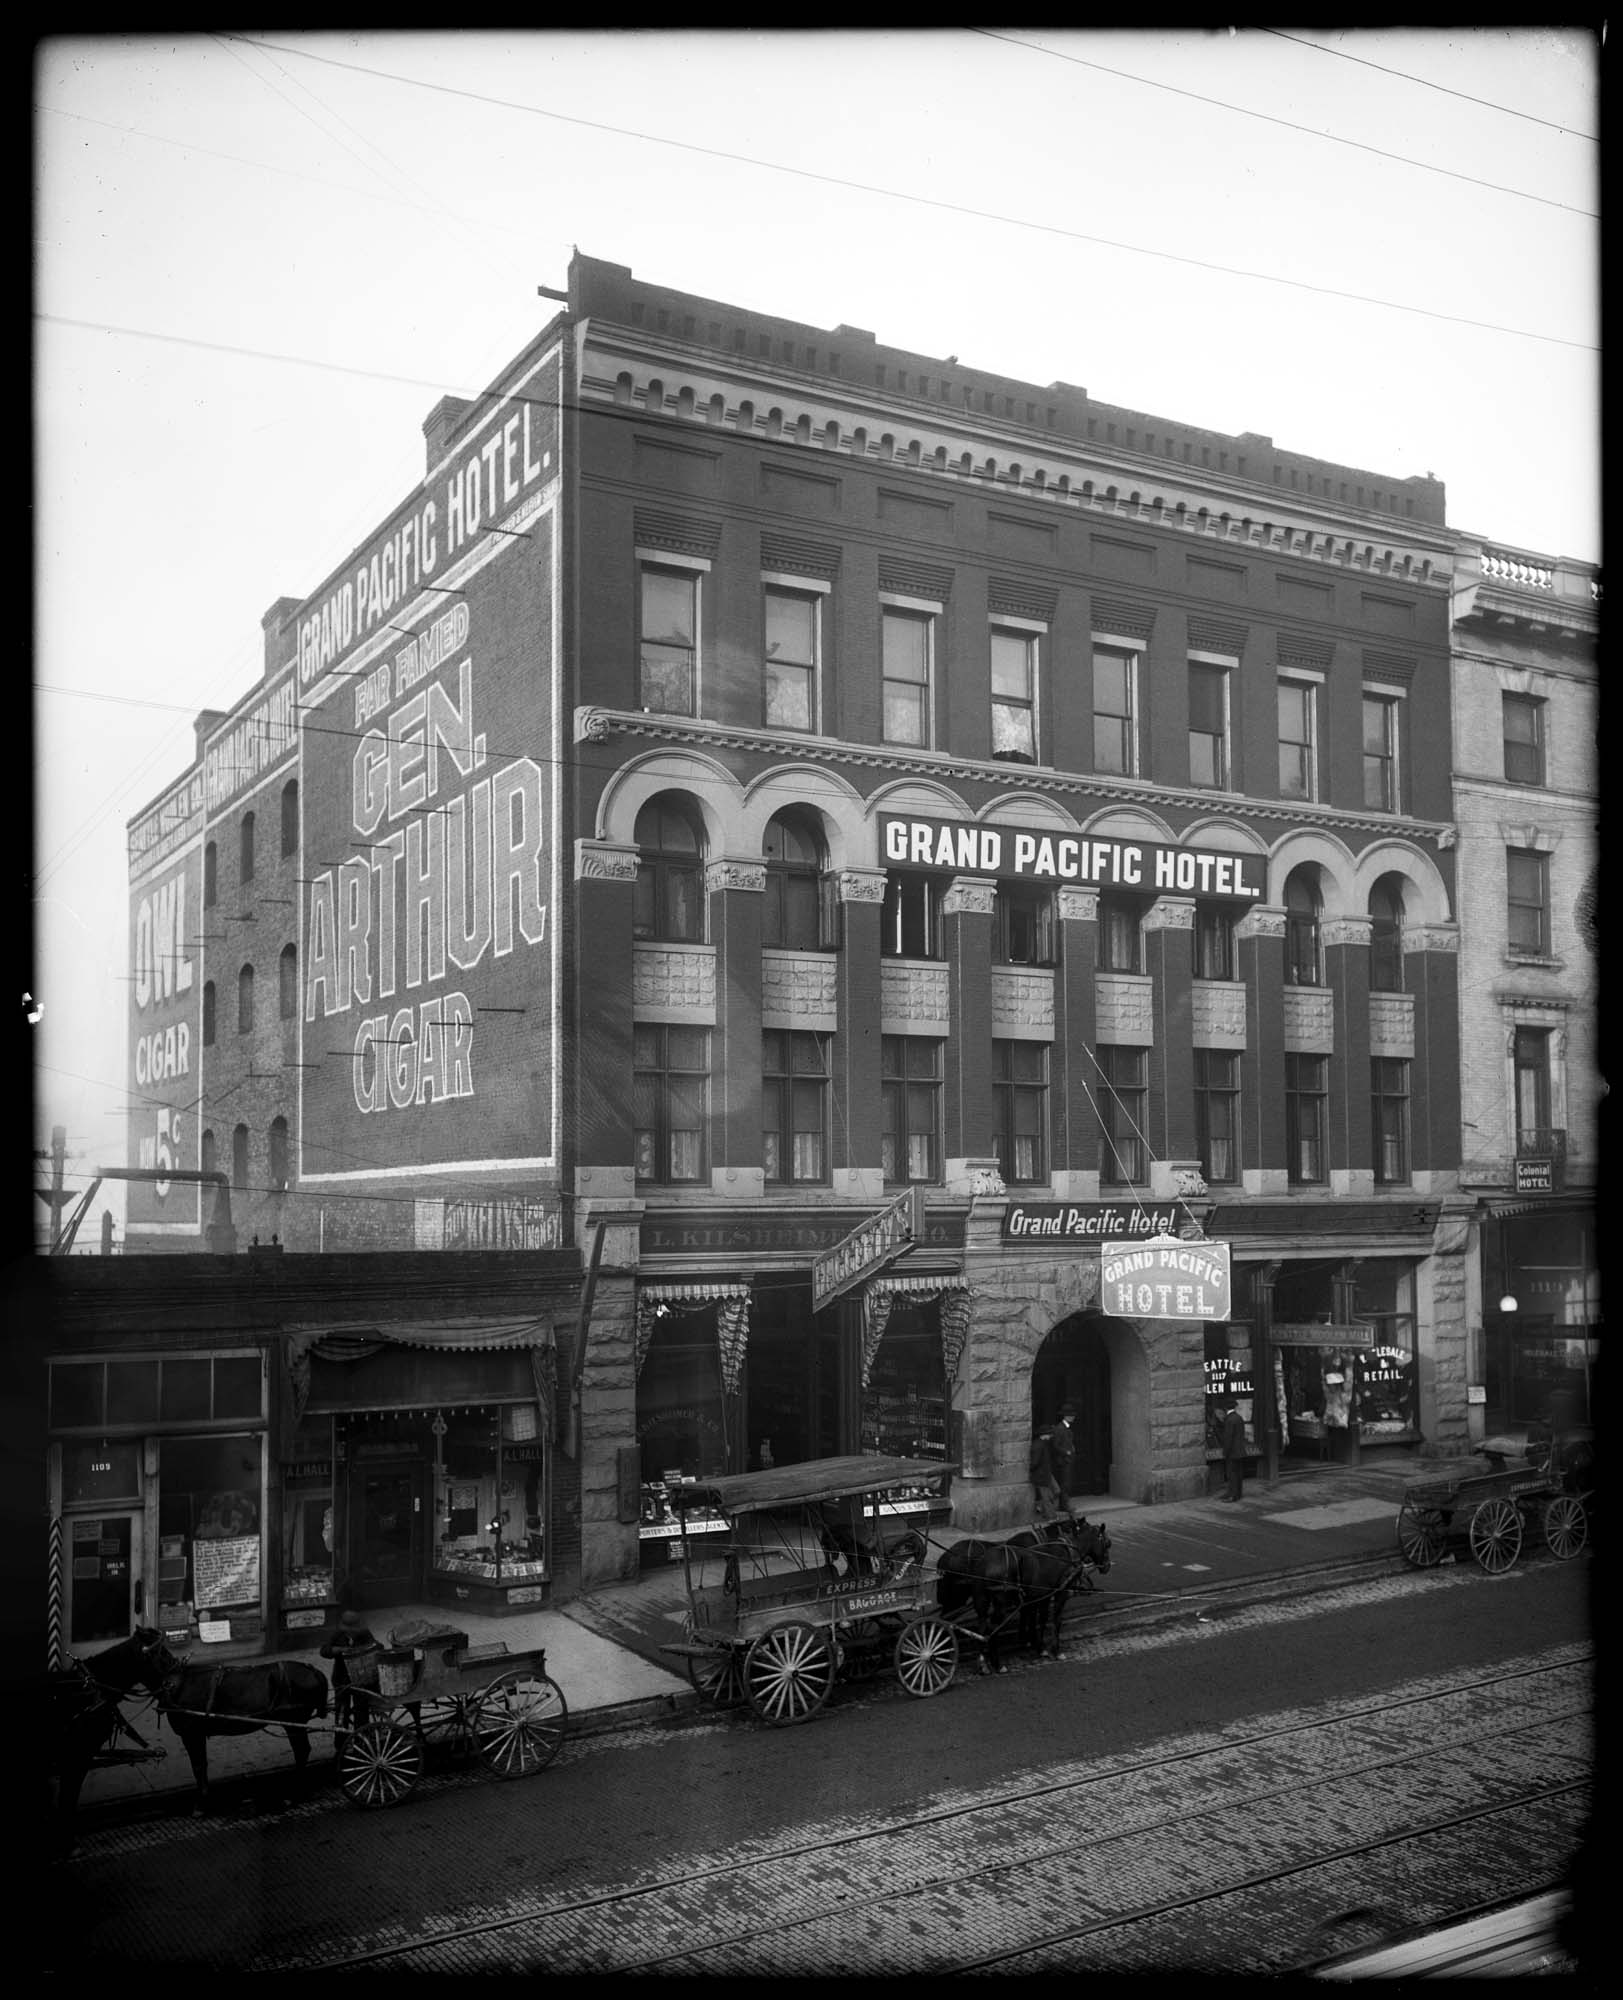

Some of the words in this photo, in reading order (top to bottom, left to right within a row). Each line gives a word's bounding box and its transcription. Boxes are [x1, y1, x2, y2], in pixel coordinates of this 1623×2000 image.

[301, 580, 353, 685] GRAND
[357, 500, 437, 636] PACIFIC
[354, 662, 391, 729] FAR
[395, 601, 470, 698] FAMED
[353, 656, 487, 836] GEN.
[886, 820, 1001, 872] GRAND
[1014, 834, 1142, 885] PACIFIC
[1155, 851, 1261, 898] HOTEL.
[305, 758, 547, 1023] ARTHUR
[135, 871, 194, 1010] OWL
[135, 1021, 190, 1086] CIGAR
[353, 991, 475, 1114] CIGAR
[1519, 1164, 1550, 1176] Colonial
[1519, 1178, 1551, 1188] HOTEL
[1009, 1208, 1064, 1235] Grand
[1065, 1208, 1125, 1235] Pacific
[1128, 1208, 1177, 1234] Hotel.
[1105, 1250, 1154, 1283] GRAND
[1160, 1250, 1223, 1288] PACIFIC
[1118, 1283, 1215, 1315] HOTEL
[1204, 1359, 1242, 1373] EATTLE
[1205, 1383, 1225, 1394] LEN
[826, 1578, 877, 1595] EXPRESS
[849, 1592, 897, 1611] BAGGAGE
